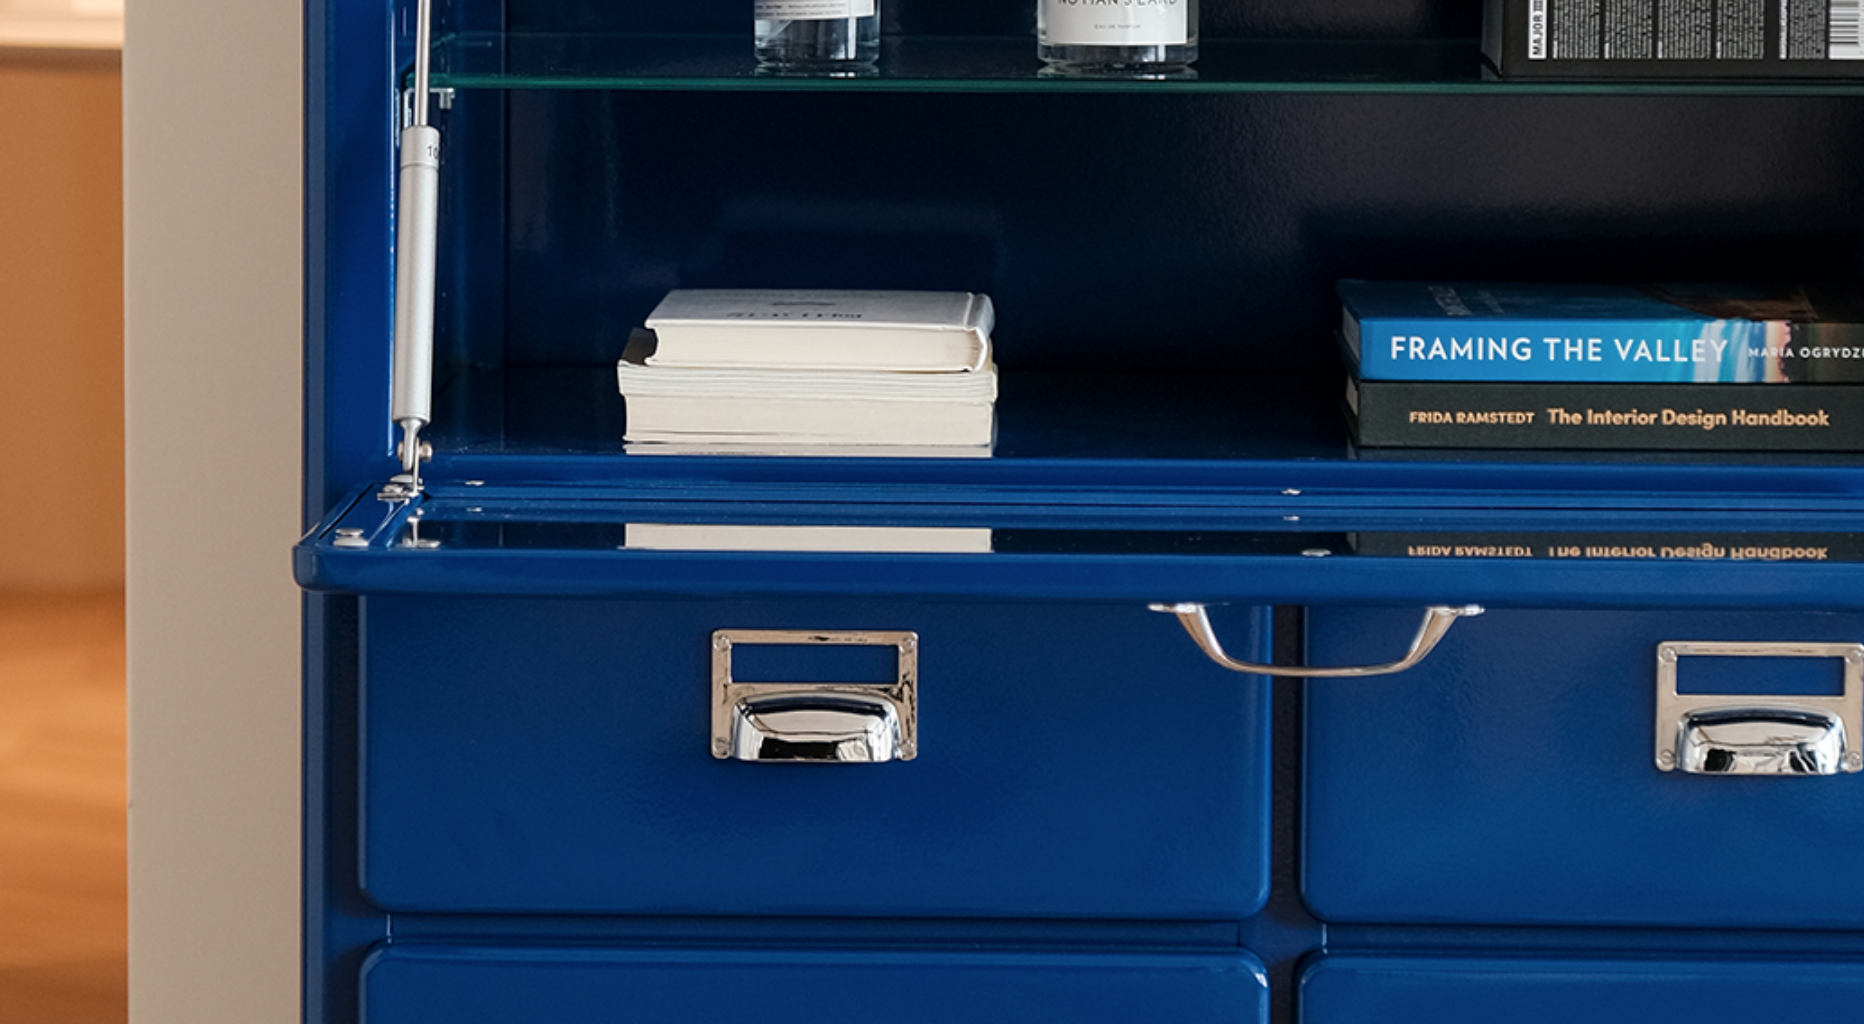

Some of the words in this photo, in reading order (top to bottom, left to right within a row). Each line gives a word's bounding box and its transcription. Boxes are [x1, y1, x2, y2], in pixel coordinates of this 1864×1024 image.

[1532, 14, 1544, 55] MAJOR
[1391, 336, 1533, 360] FRAMING
[1543, 337, 1602, 361] THE
[1614, 339, 1729, 362] VALLEY
[1748, 347, 1794, 358] MARIA
[1409, 411, 1453, 424] FRIDA
[1456, 411, 1534, 425] RAMSTEDT
[1547, 408, 1582, 425] The
[1587, 408, 1658, 426] Interior
[1662, 409, 1727, 431] Design
[1731, 409, 1830, 427] Handbook
